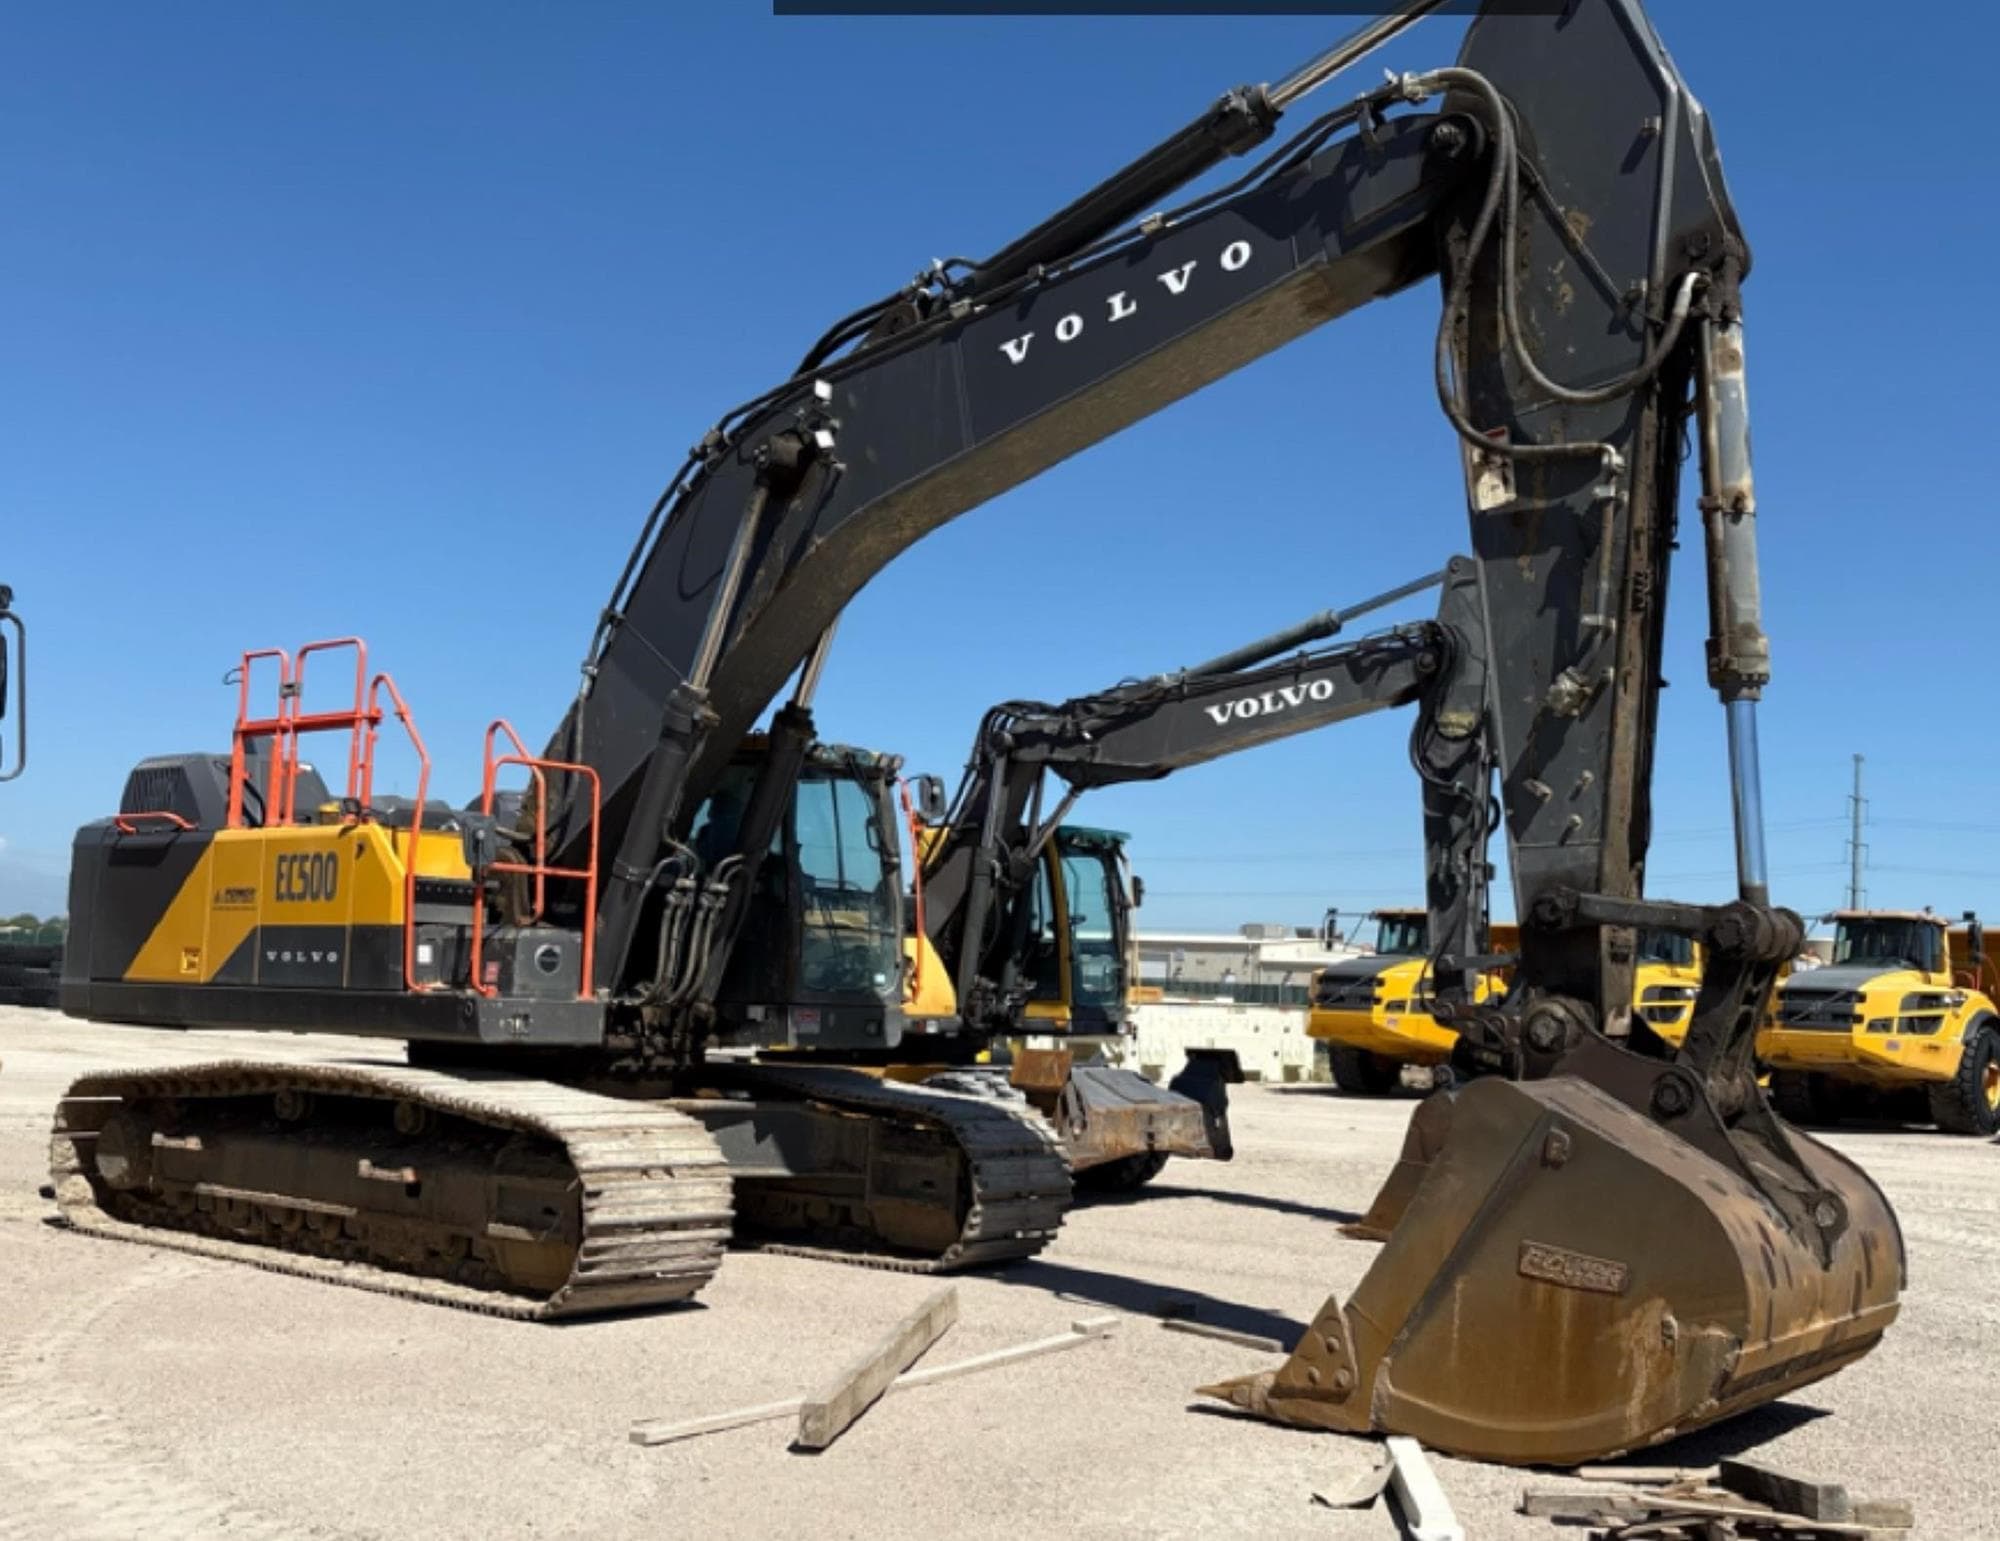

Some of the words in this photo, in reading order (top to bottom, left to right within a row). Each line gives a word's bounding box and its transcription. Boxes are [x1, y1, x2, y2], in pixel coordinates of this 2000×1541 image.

[999, 240, 1252, 364] VOLVO
[1204, 679, 1334, 725] VOLVO
[275, 851, 338, 902] EC500
[266, 951, 338, 963] VOLVO
